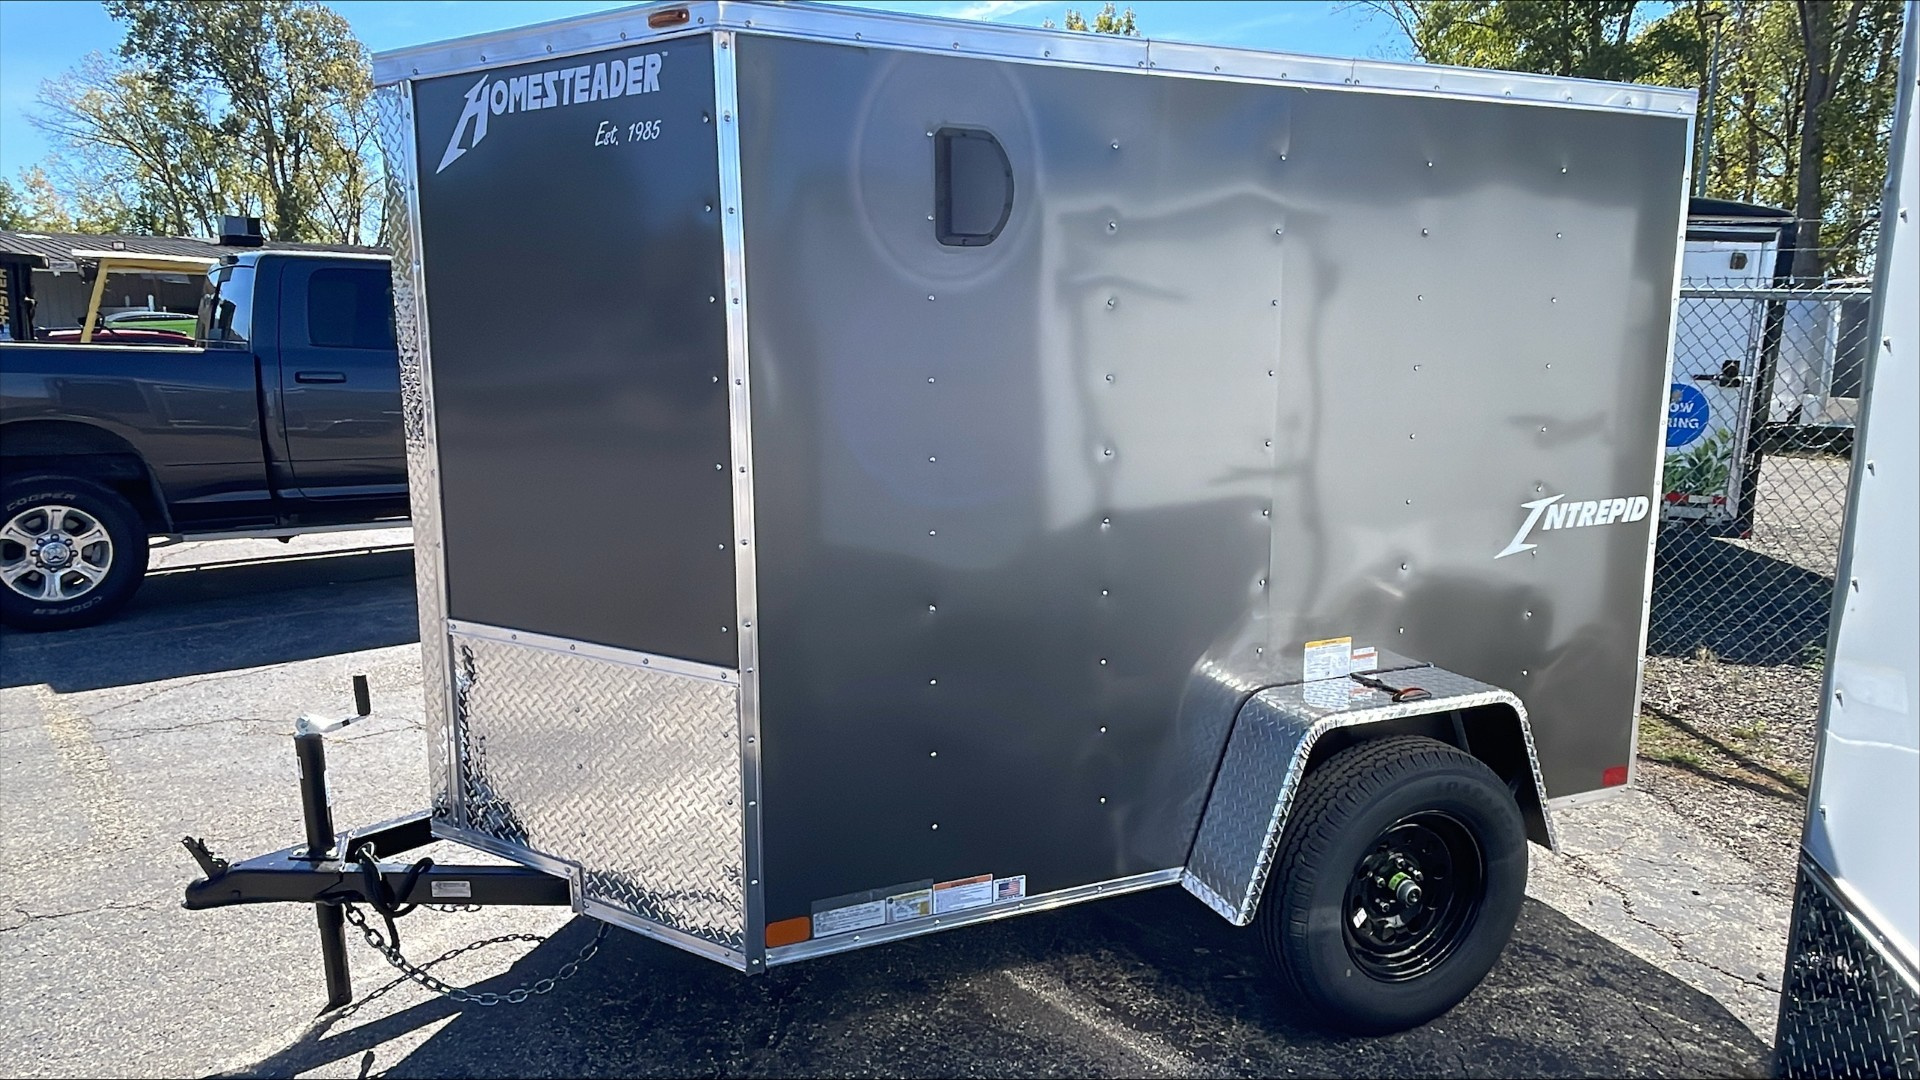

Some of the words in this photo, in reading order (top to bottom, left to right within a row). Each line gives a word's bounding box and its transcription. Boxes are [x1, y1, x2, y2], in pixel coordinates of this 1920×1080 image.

[436, 53, 662, 174] HOMESTEADER
[595, 121, 619, 146] Est.
[628, 119, 662, 142] 1985
[1669, 402, 1695, 413] OW
[6, 491, 77, 512] COOPER
[1494, 494, 1650, 560] INTREPID
